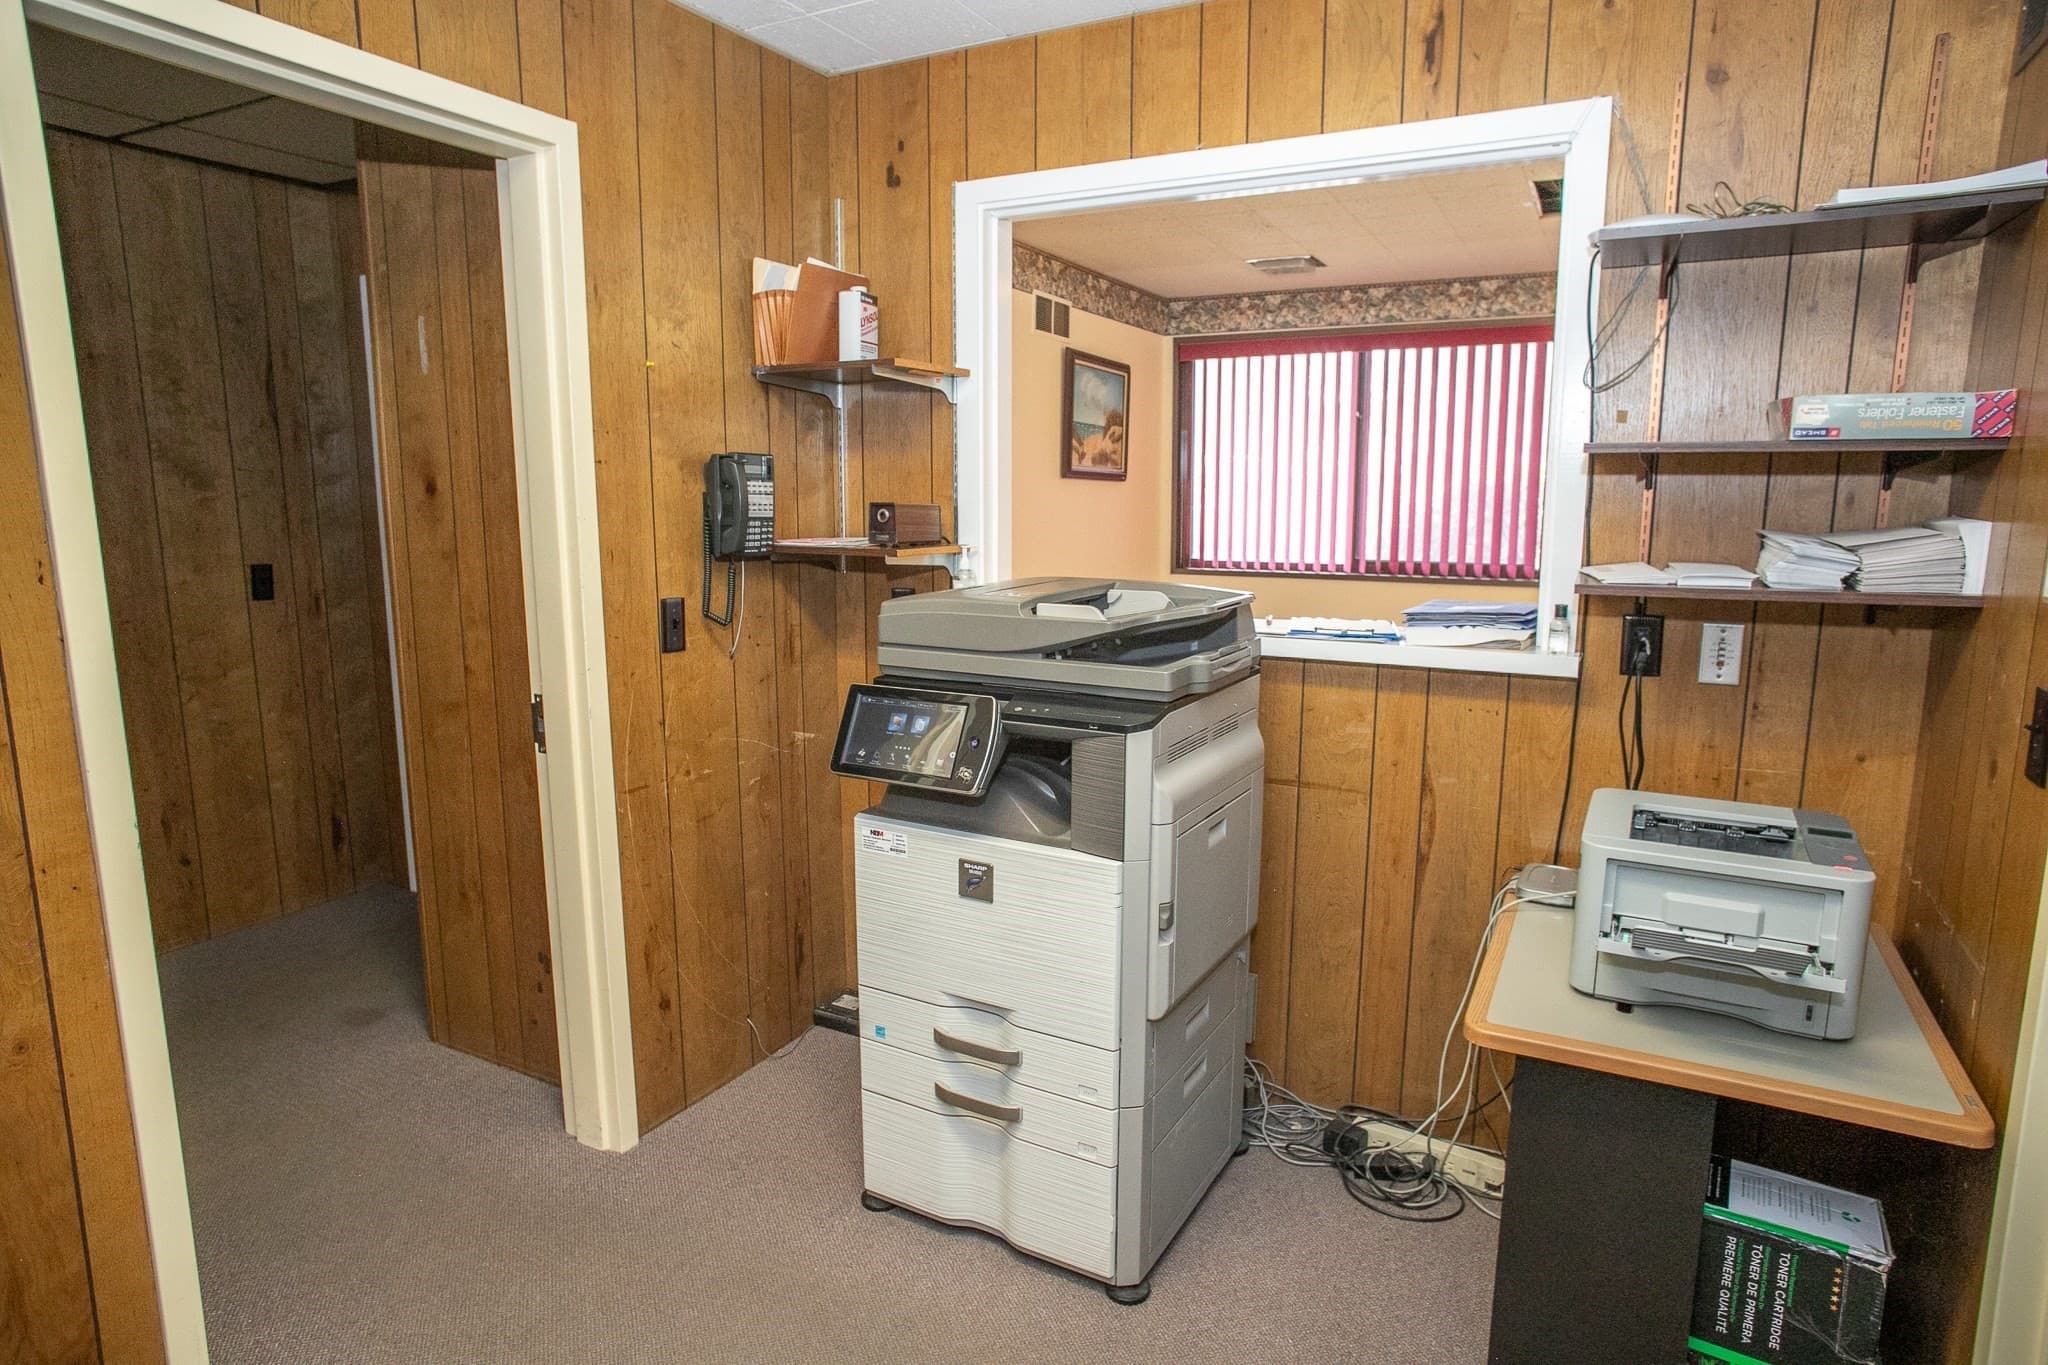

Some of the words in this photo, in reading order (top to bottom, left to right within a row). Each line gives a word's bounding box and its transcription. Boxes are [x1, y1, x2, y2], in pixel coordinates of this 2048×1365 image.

[1857, 407, 1905, 420] Folders
[1908, 405, 1966, 418] Fastener
[1794, 429, 1827, 437] SMEAD
[1987, 417, 2011, 434] SMEAD
[963, 862, 988, 872] SHARP
[1720, 1235, 1737, 1288] PREMIÈRE
[1748, 1244, 1764, 1281] TÓNER
[1776, 1252, 1791, 1288] TONER
[1746, 1281, 1759, 1298] DE
[1715, 1289, 1731, 1335] QUALITÉ
[1741, 1298, 1756, 1343] PRIMERA
[1768, 1290, 1787, 1351] CARTRIDGE
